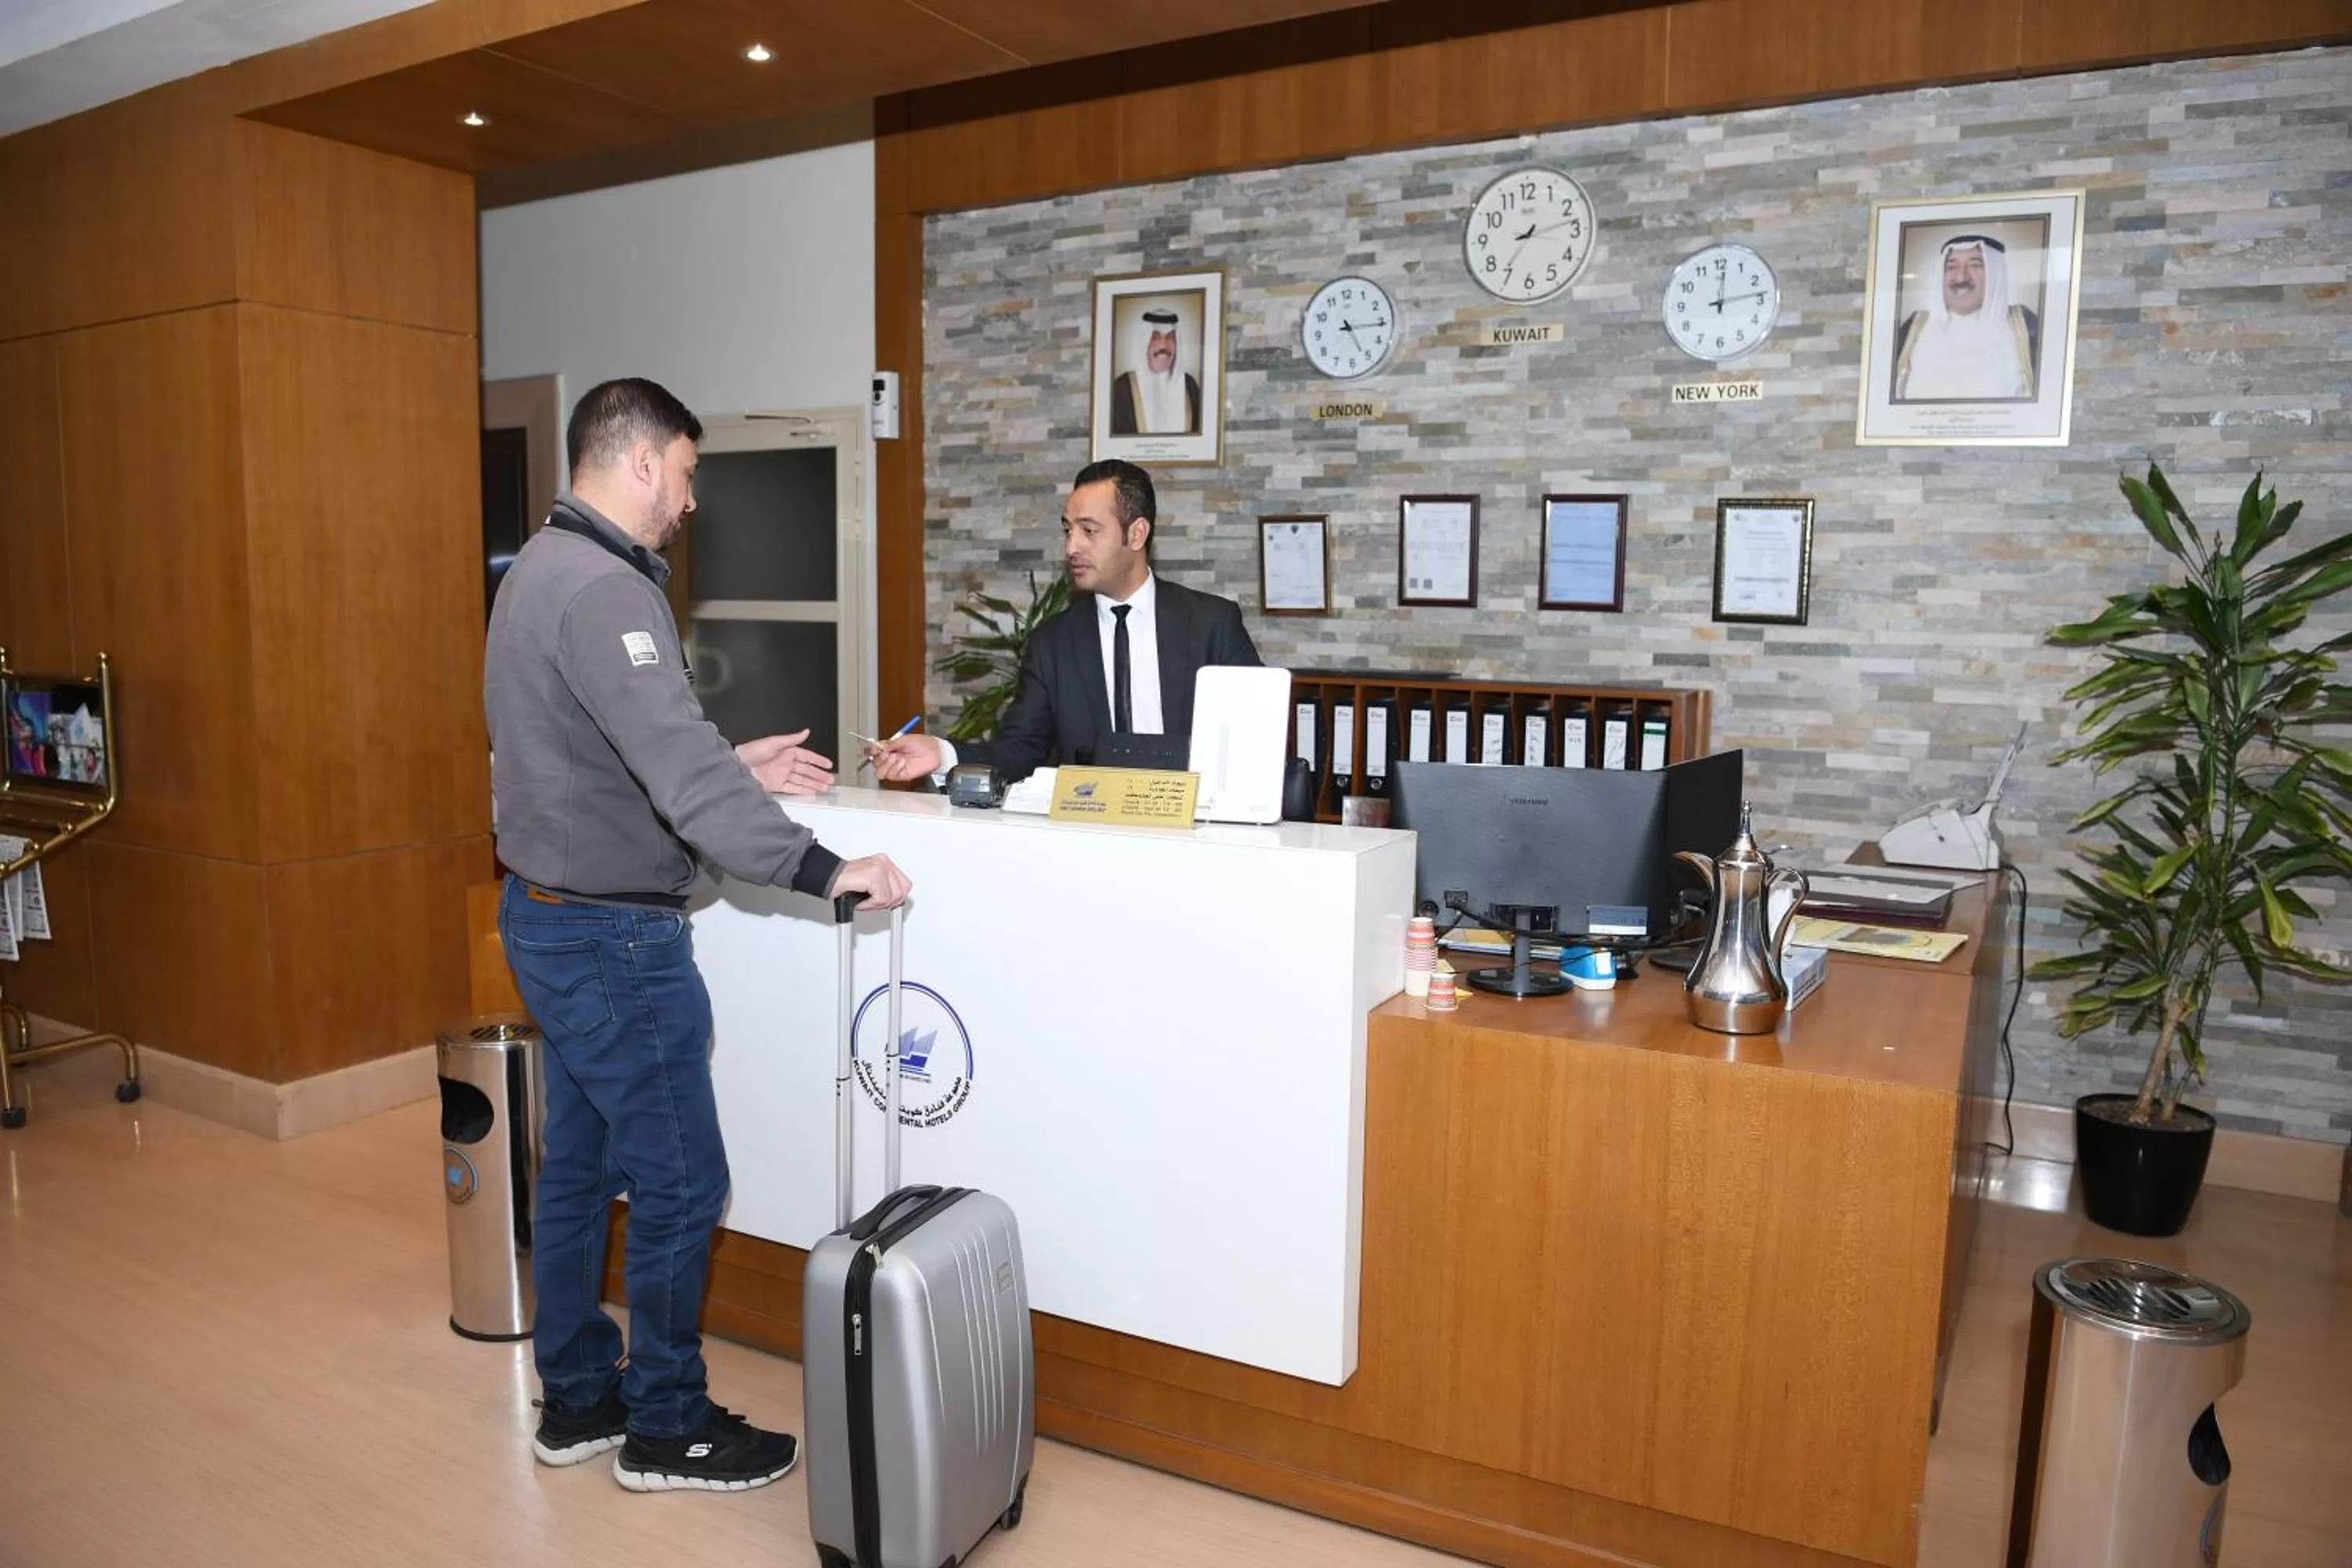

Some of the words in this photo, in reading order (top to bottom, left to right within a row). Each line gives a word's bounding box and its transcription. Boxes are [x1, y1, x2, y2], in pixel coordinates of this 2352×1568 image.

[1519, 182, 1536, 201] 12
[1547, 185, 1553, 202] 1
[1501, 192, 1515, 210] 11
[1562, 198, 1572, 216] 2
[1486, 211, 1503, 229] 10
[1570, 219, 1581, 239] 3
[1478, 234, 1488, 251] 9
[1562, 246, 1573, 263] 4
[1486, 255, 1497, 272] 8
[1714, 259, 1727, 270] 12
[1738, 262, 1744, 273] 1
[1503, 267, 1513, 286] 7
[1545, 263, 1556, 281] 5
[1696, 266, 1707, 277] 11
[1524, 274, 1534, 289] 6
[1750, 274, 1759, 287] 2
[1681, 281, 1694, 293] 10
[1341, 289, 1352, 300] 12
[1327, 297, 1337, 308] 11
[1371, 300, 1379, 311] 2
[1677, 301, 1685, 313] 9
[1317, 311, 1327, 322] 10
[1750, 314, 1759, 325] 4
[1682, 320, 1690, 332] 8
[1314, 330, 1322, 342] 9
[1375, 335, 1382, 345] 4
[1493, 327, 1550, 343] KUWAIT
[1697, 333, 1706, 345] 7
[1737, 329, 1744, 341] 5
[1716, 336, 1724, 349] 6
[1320, 347, 1327, 358] 8
[1364, 350, 1371, 361] 5
[1333, 355, 1340, 366] 7
[1349, 358, 1356, 368] 6
[1675, 387, 1711, 401] NEW
[1716, 384, 1759, 399] YORK
[1319, 404, 1373, 418] LONDON
[924, 1109, 953, 1127] HOTELS
